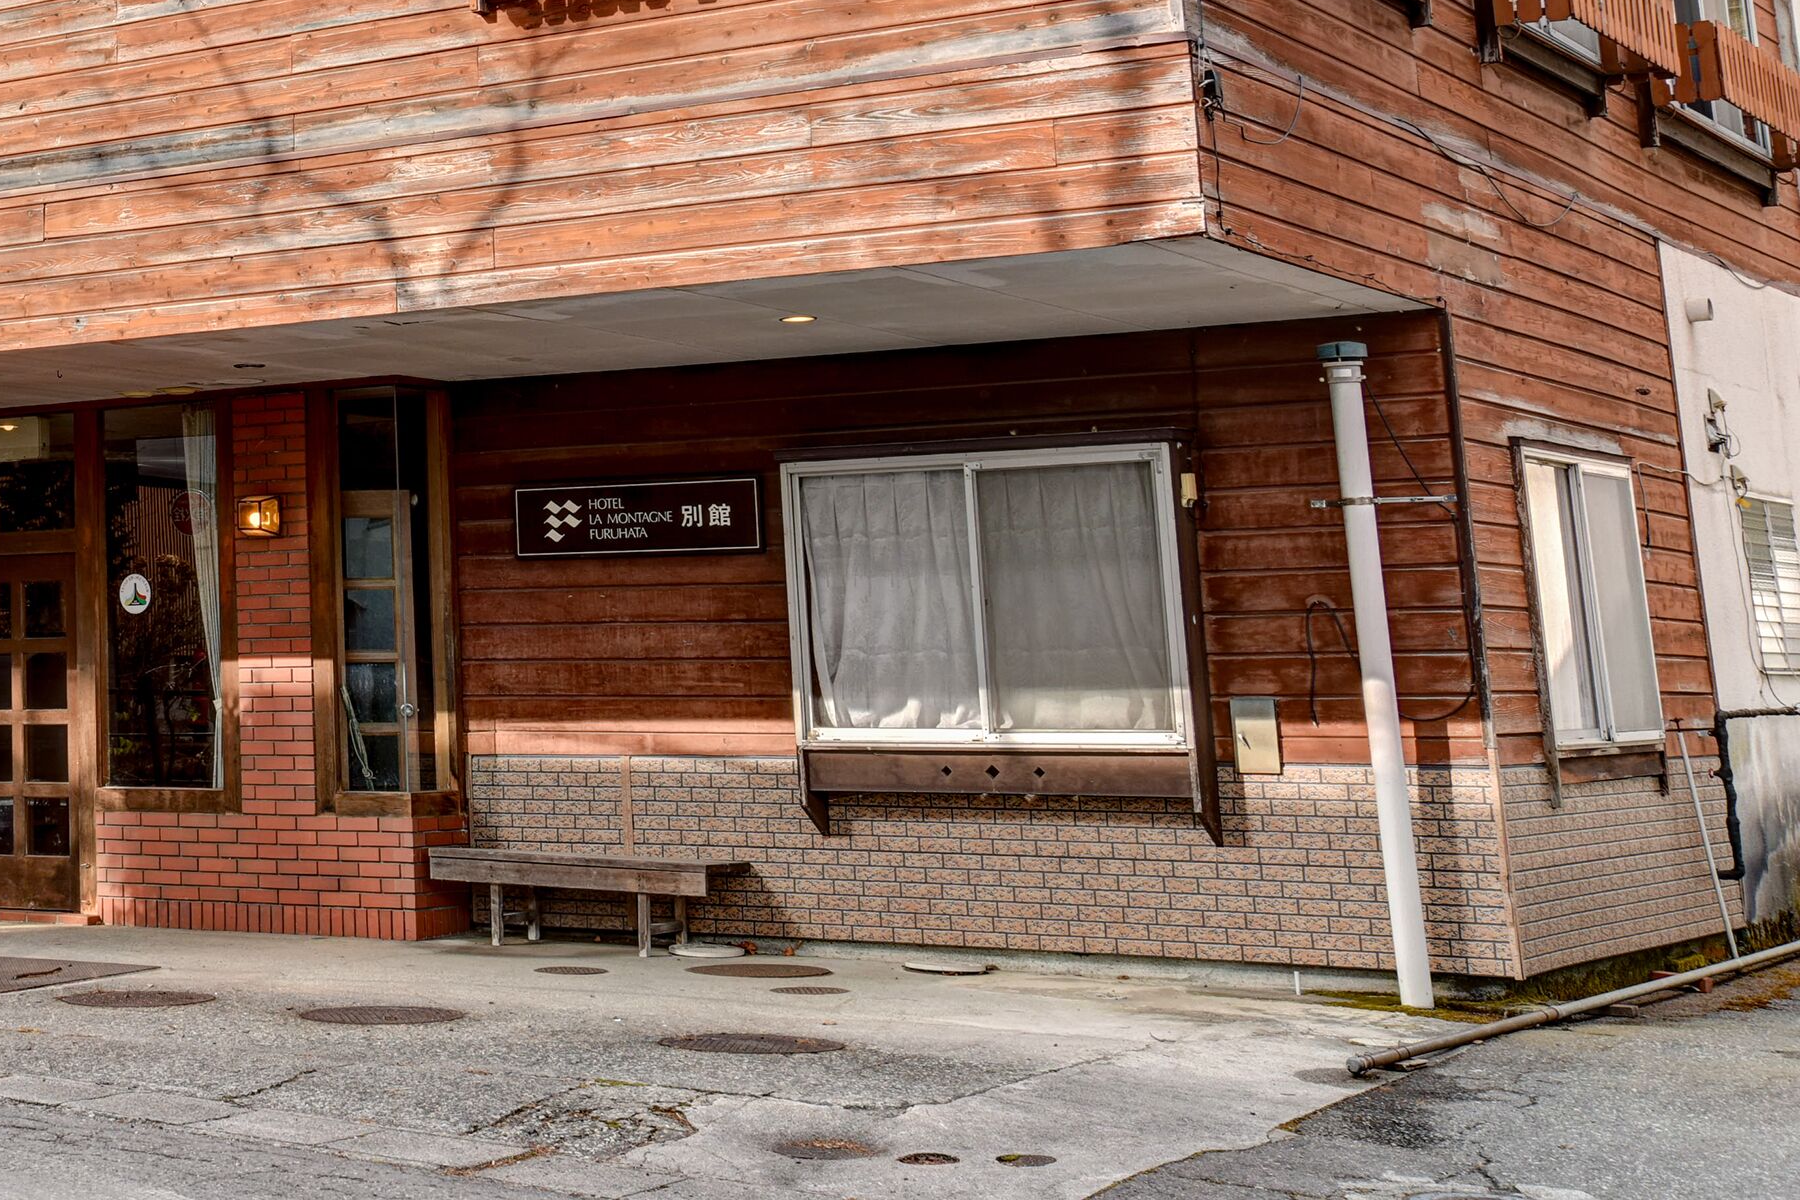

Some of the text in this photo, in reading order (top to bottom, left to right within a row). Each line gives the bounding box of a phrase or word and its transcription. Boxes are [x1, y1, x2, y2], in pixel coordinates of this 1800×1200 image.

[588, 498, 625, 510] HOTEL
[589, 511, 673, 525] LA MONTAGNE
[681, 503, 732, 528] 別館
[590, 527, 649, 540] FURUHATA
